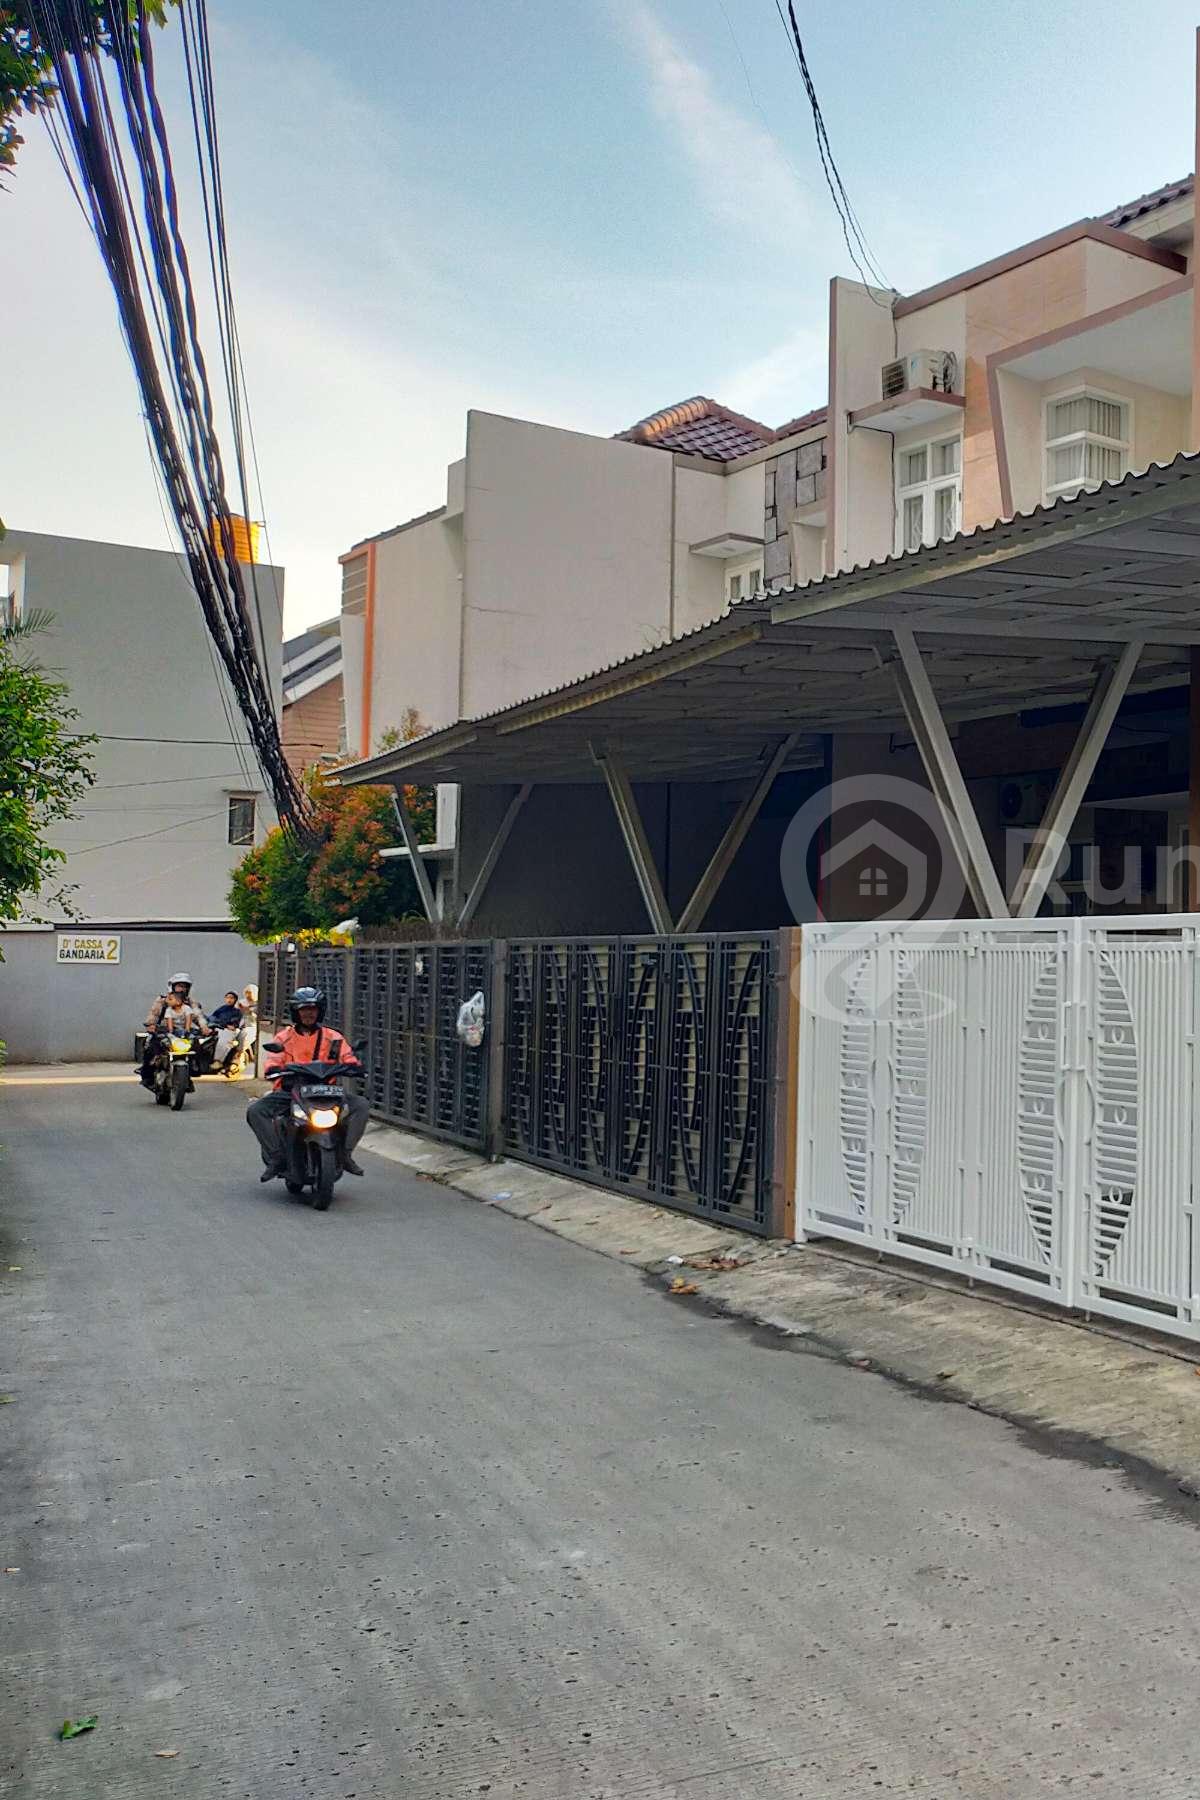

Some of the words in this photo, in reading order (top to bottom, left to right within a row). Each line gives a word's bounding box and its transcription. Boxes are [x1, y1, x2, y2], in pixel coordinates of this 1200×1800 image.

[59, 949, 106, 959] GANDARIA
[107, 939, 118, 960] 2
[74, 939, 103, 949] CASSA
